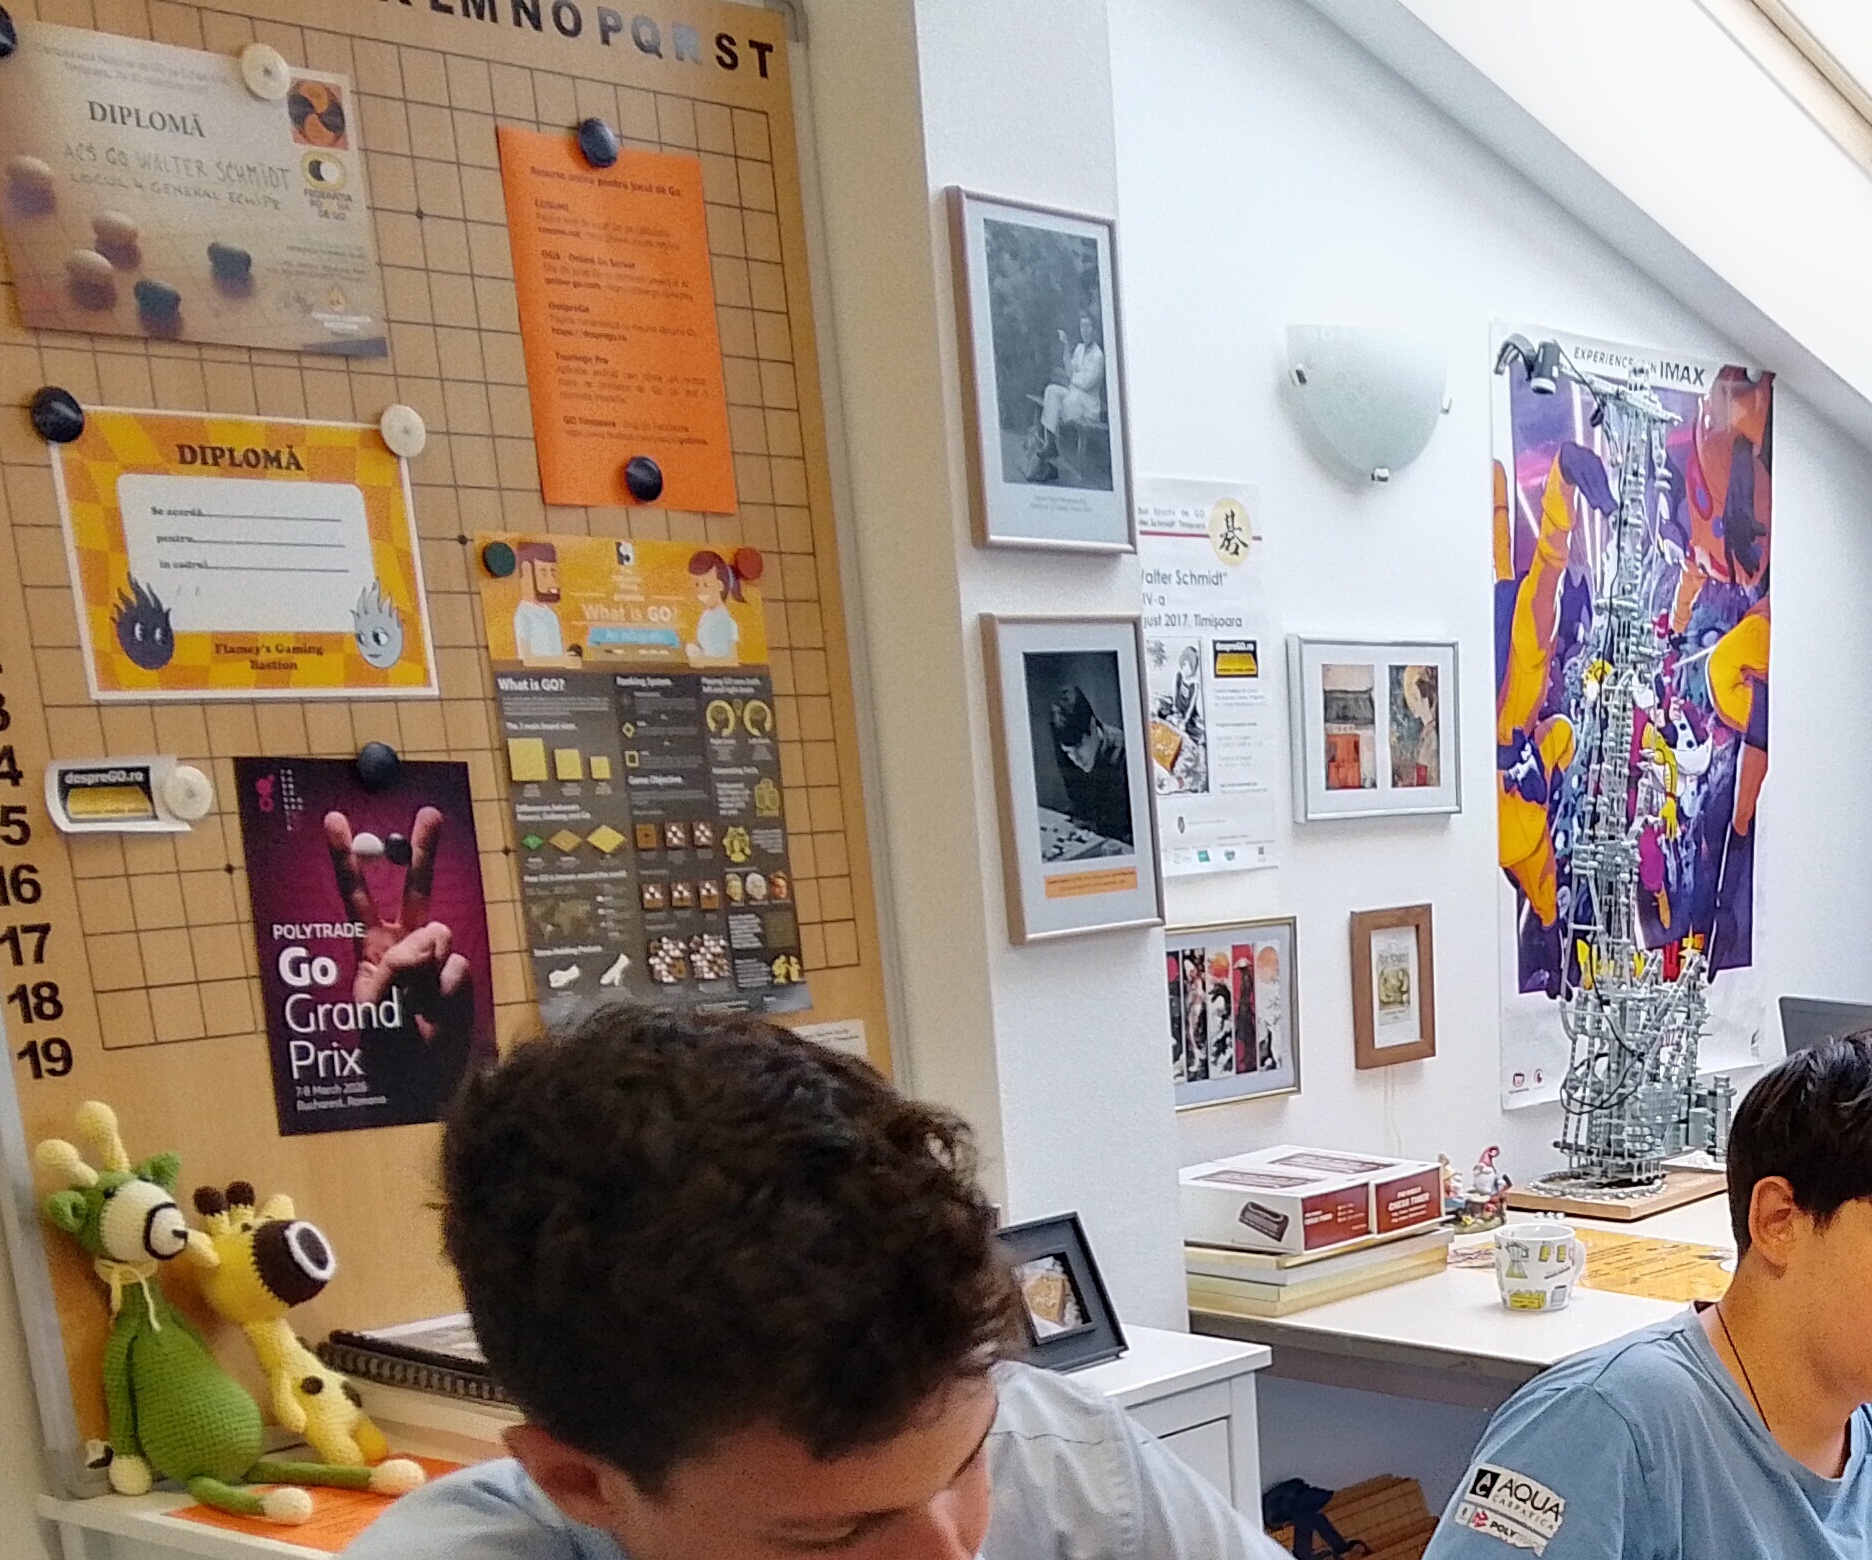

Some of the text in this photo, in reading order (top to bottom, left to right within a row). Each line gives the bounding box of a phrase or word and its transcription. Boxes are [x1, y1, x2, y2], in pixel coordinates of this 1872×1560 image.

[715, 32, 739, 71] S
[748, 39, 773, 80] T
[1659, 360, 1706, 387] IMAX
[176, 443, 305, 472] DIPLOMĂ
[582, 603, 627, 622] What
[497, 677, 566, 691] What is GO?
[0, 923, 51, 966] 17
[273, 922, 366, 940] POLYTRADE
[279, 946, 338, 987] Go
[7, 980, 64, 1025] 18
[285, 986, 403, 1033] Grand
[17, 1037, 73, 1080] 19
[289, 1040, 365, 1080] Prix
[1492, 1495, 1554, 1531] CARPATICA
[1497, 1478, 1560, 1522] AQUA
